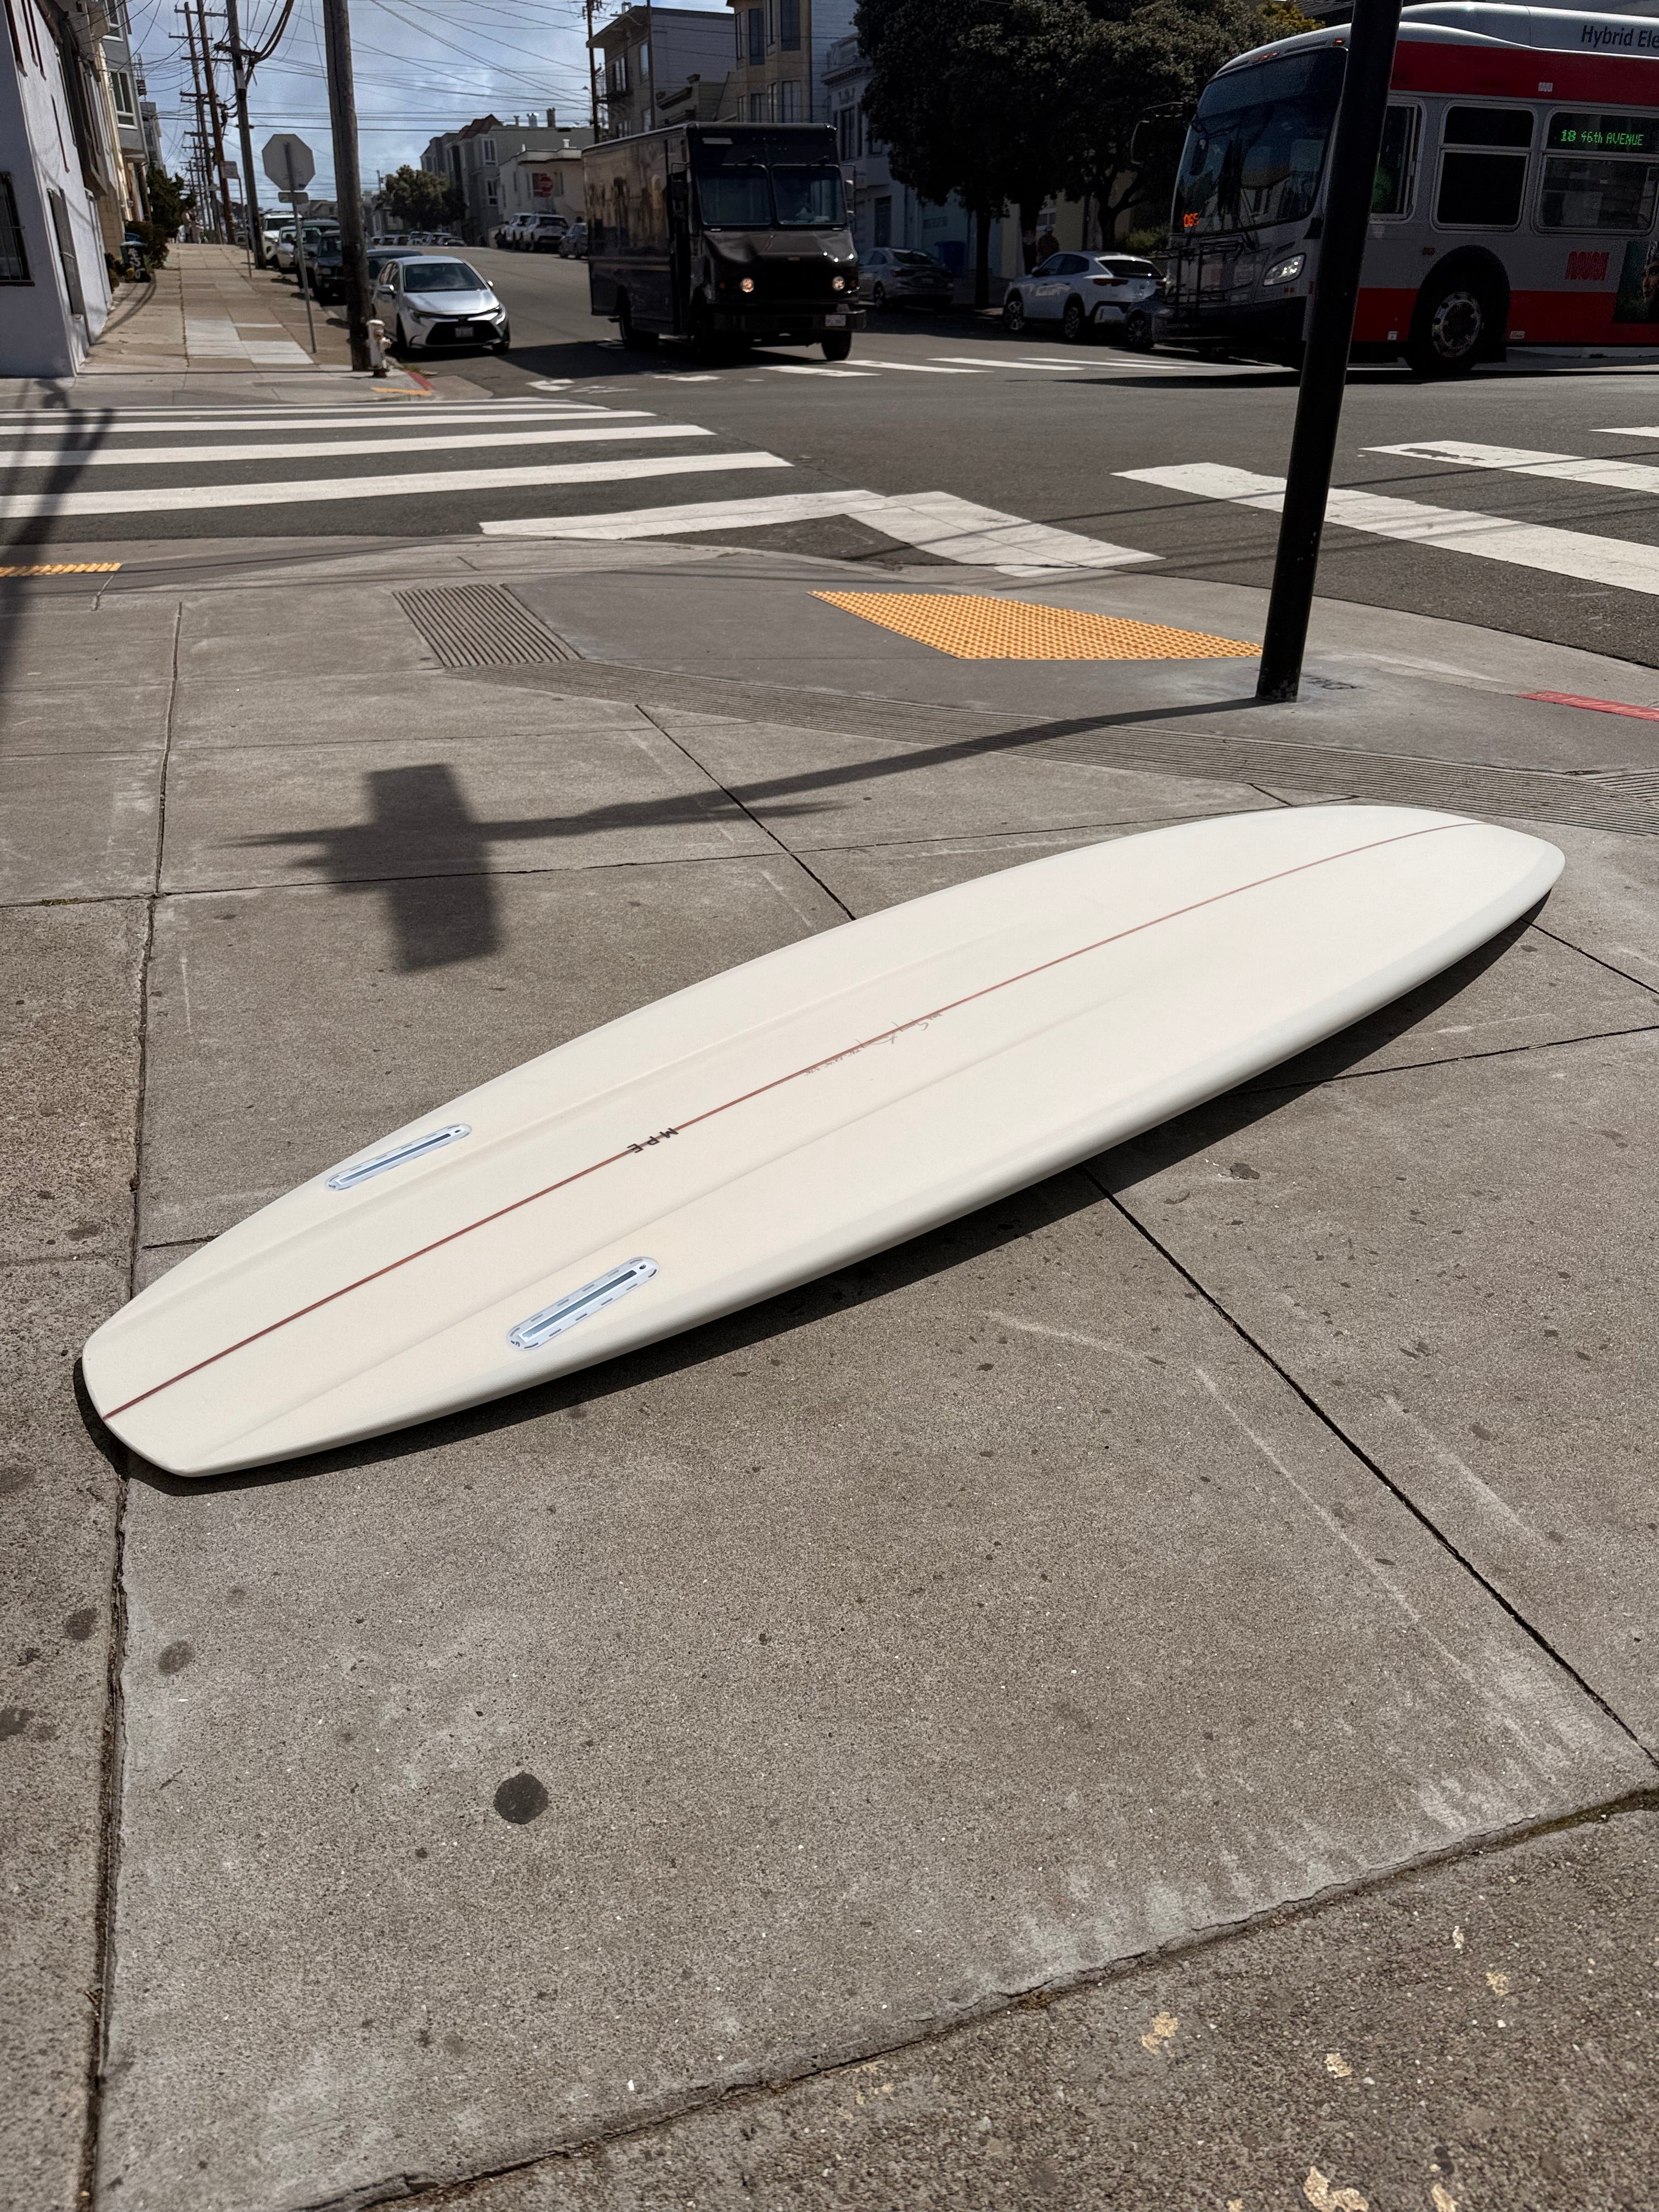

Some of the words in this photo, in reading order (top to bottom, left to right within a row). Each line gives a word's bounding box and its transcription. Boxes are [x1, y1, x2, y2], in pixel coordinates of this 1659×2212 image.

[1581, 25, 1634, 48] Hybrid
[1637, 30, 1659, 49] Ele
[1561, 129, 1577, 142] 18
[1581, 131, 1602, 143] 46th
[1606, 132, 1645, 146] AVENUE
[626, 1127, 679, 1154] MPE
